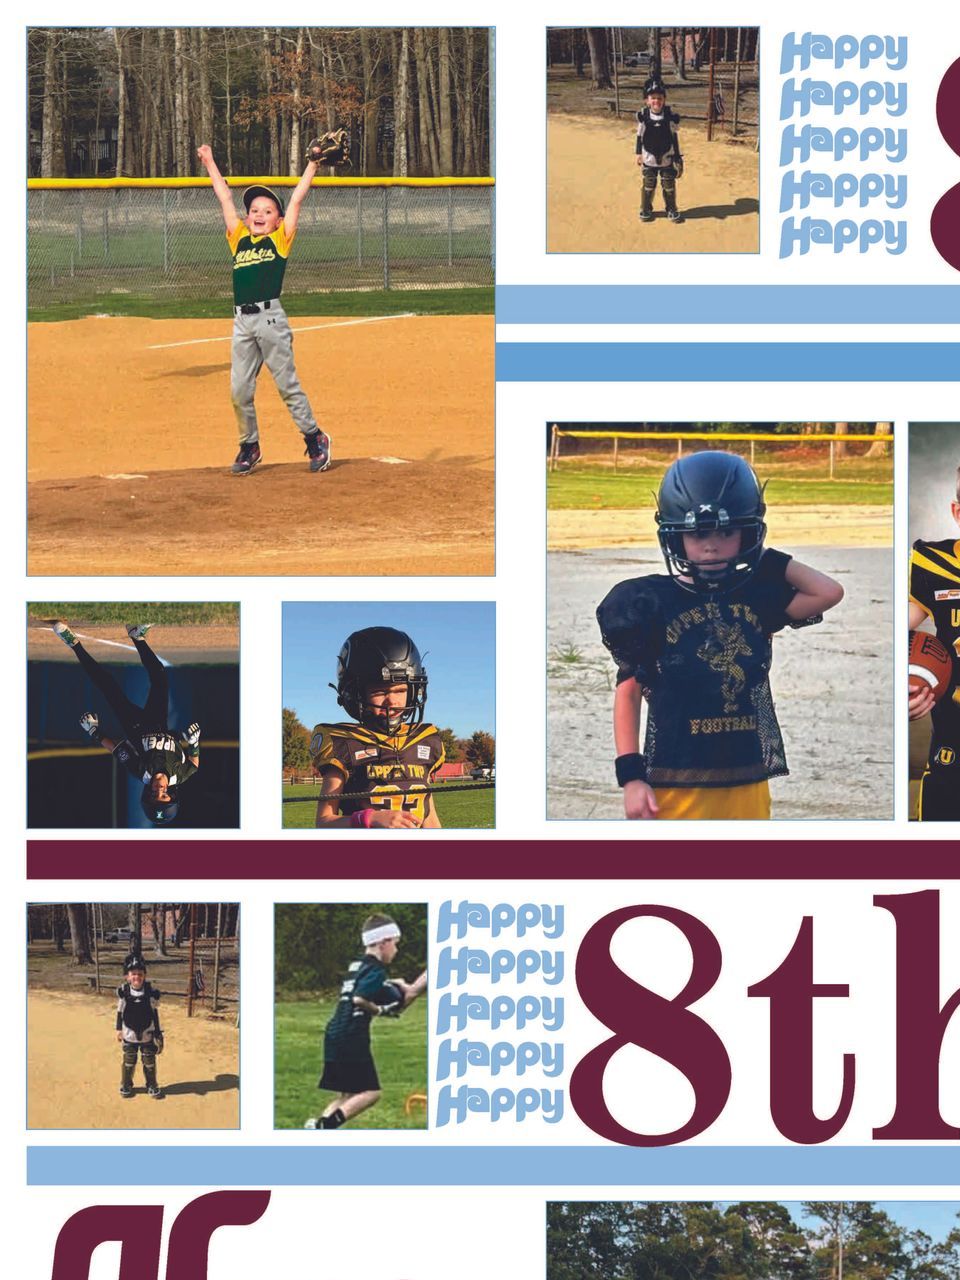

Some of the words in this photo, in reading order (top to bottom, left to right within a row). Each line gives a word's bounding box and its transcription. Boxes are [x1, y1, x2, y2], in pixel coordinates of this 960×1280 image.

[780, 32, 907, 74] Happy
[780, 78, 907, 120] Happy
[780, 125, 907, 166] Happy
[780, 171, 907, 212] Happy
[780, 217, 907, 258] Happy
[142, 736, 176, 753] UPPER
[437, 901, 564, 942] Happy
[437, 947, 564, 988] Happy
[437, 993, 564, 1034] Happy
[437, 1039, 564, 1081] Happy
[437, 1085, 564, 1127] Happy
